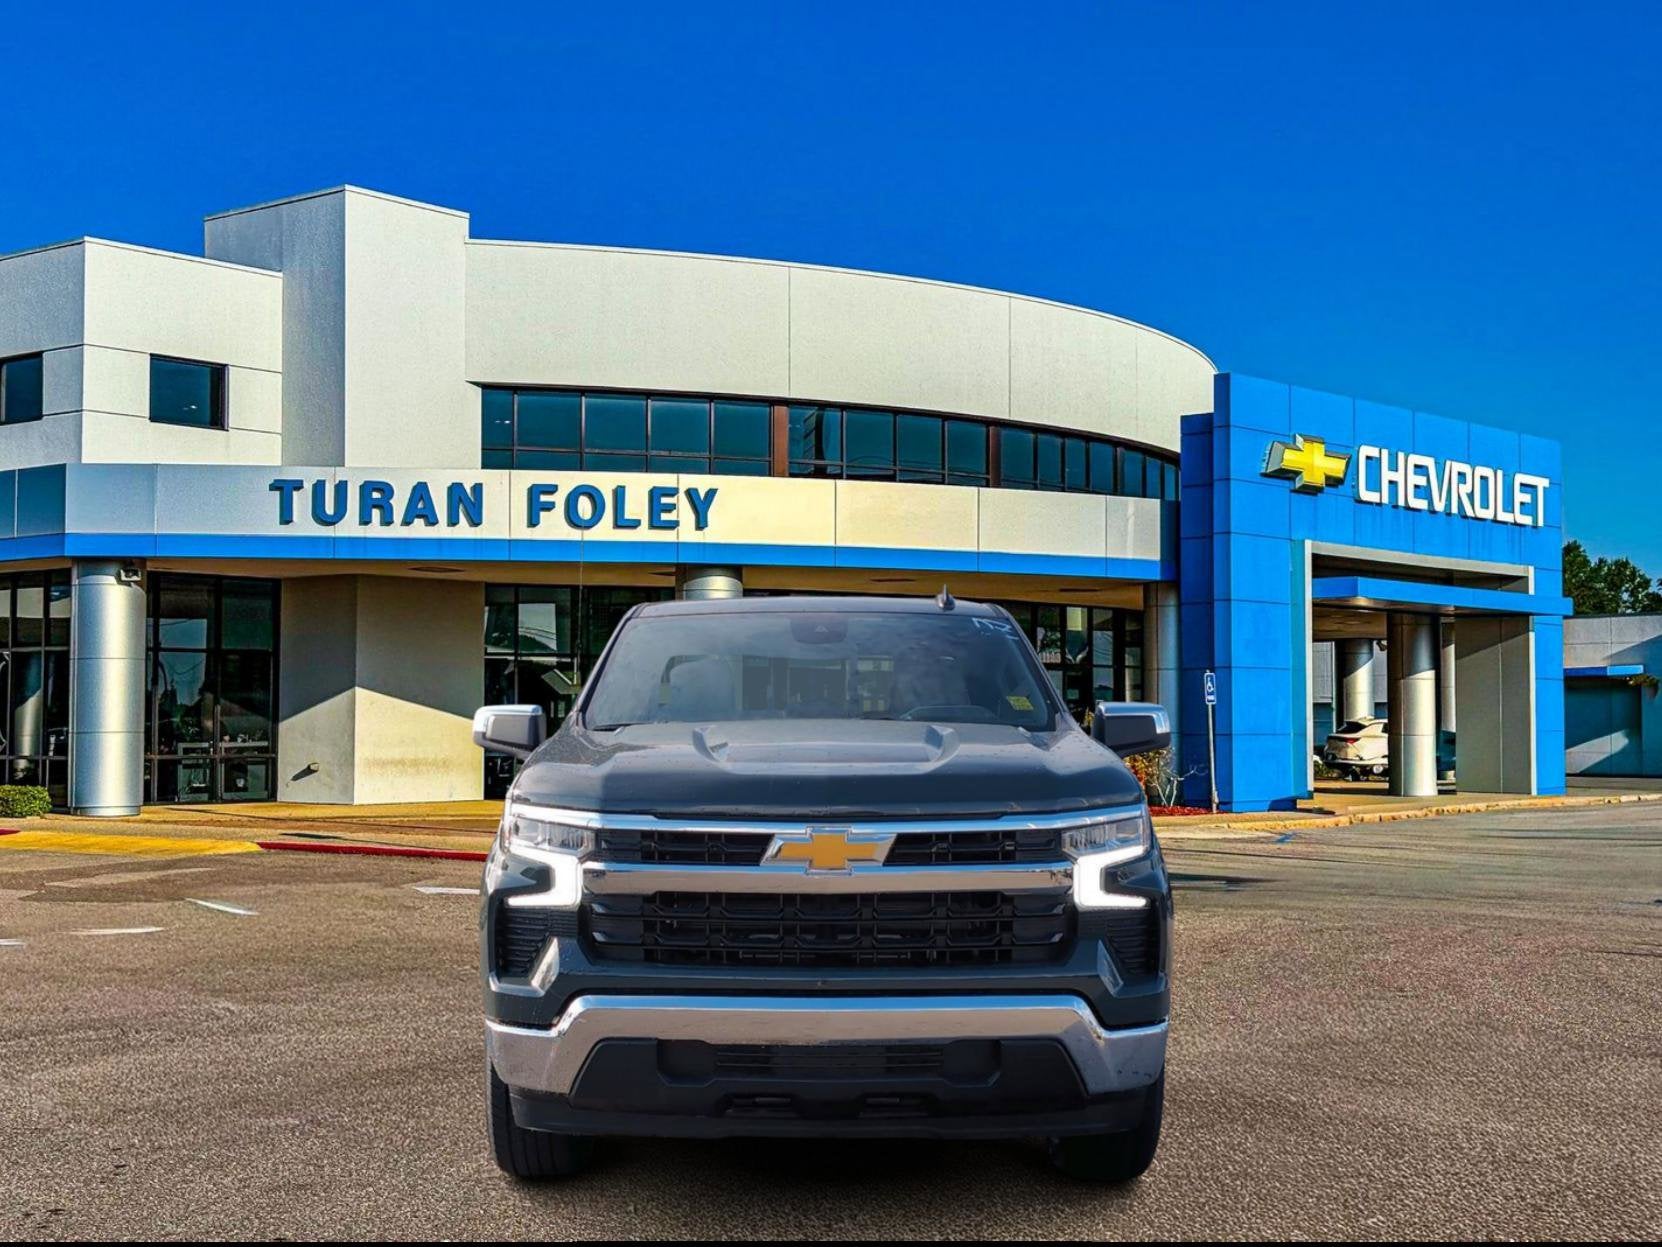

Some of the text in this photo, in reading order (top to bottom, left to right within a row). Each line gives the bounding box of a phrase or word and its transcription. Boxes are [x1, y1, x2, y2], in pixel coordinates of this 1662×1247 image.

[269, 479, 718, 531] TURAN FOLEY
[1358, 444, 1550, 527] CHEVROLET
